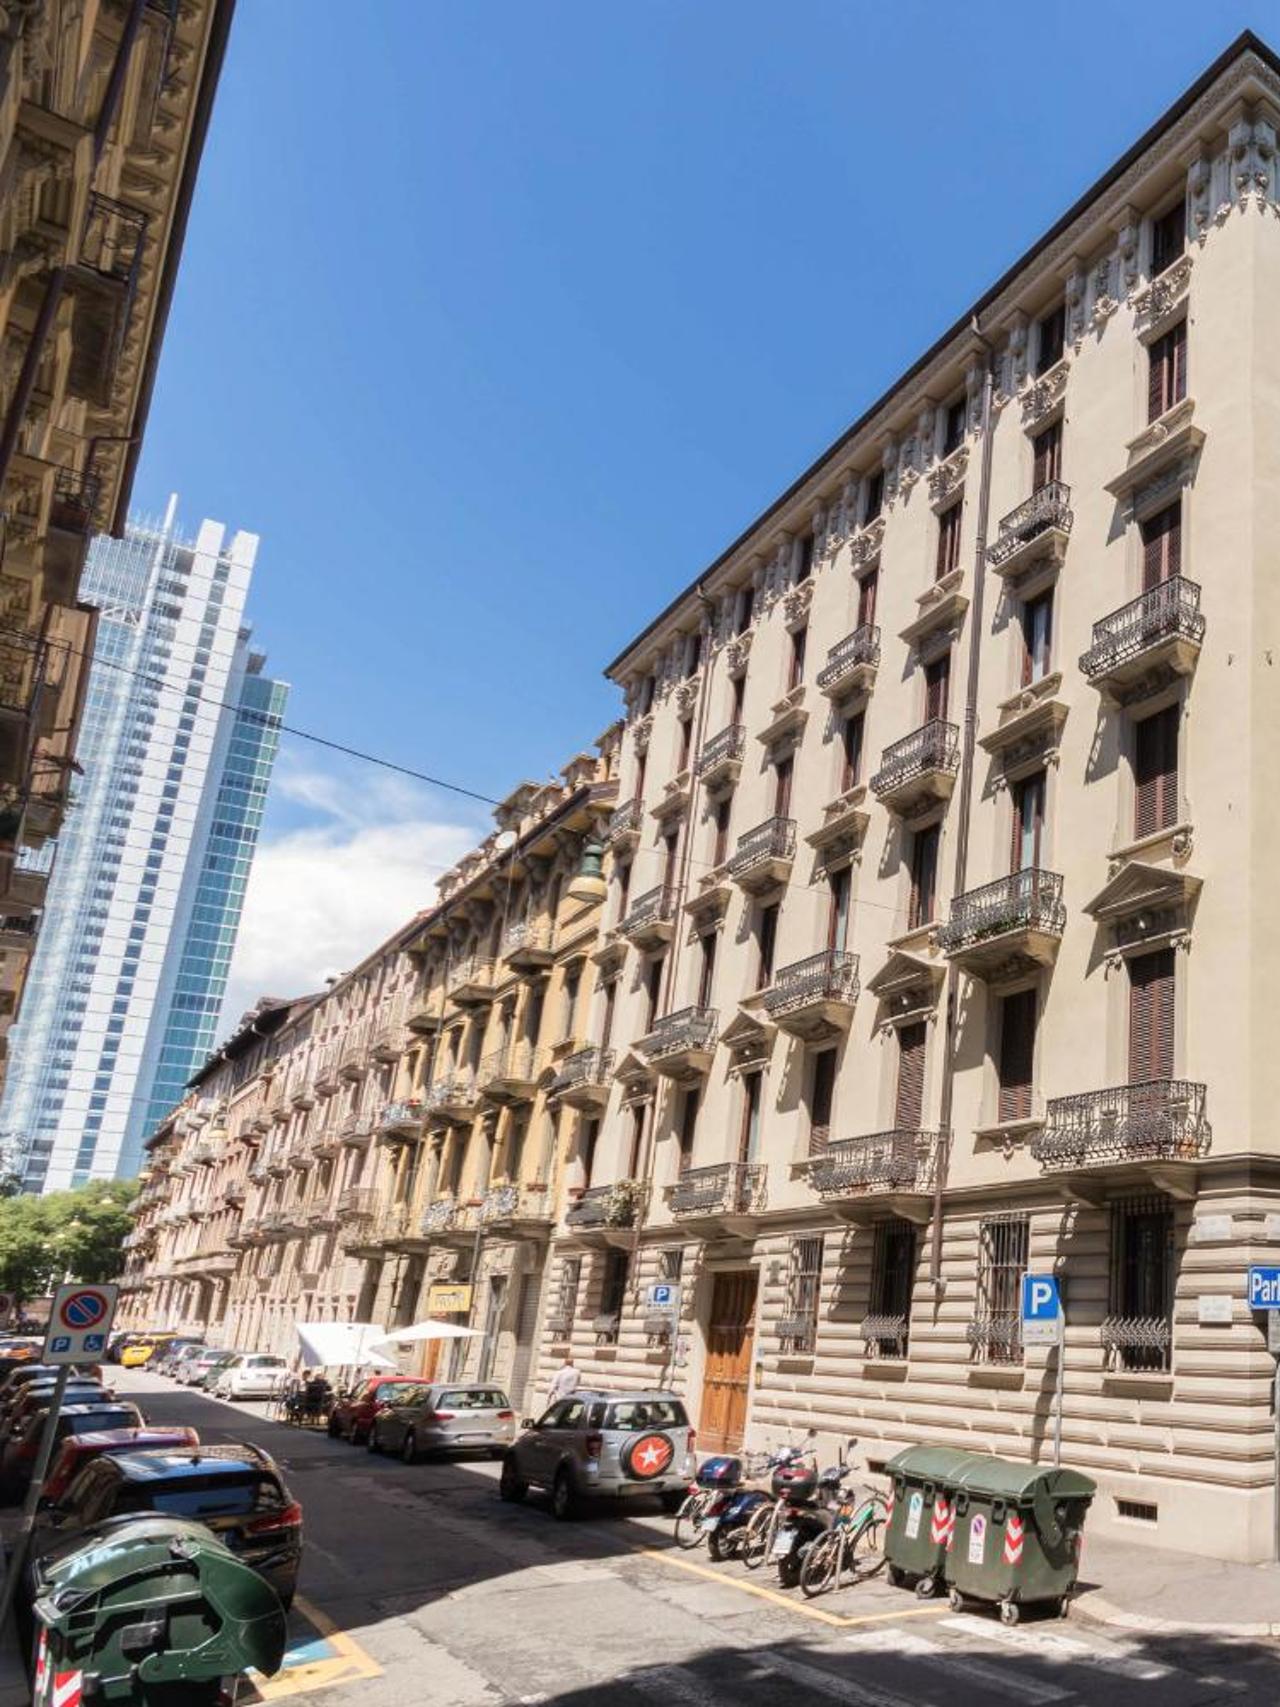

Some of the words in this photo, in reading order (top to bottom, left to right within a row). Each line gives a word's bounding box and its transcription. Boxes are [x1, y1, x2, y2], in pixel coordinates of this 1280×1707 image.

[657, 1288, 667, 1301] P
[1031, 1282, 1052, 1315] P
[55, 1339, 67, 1350] P
